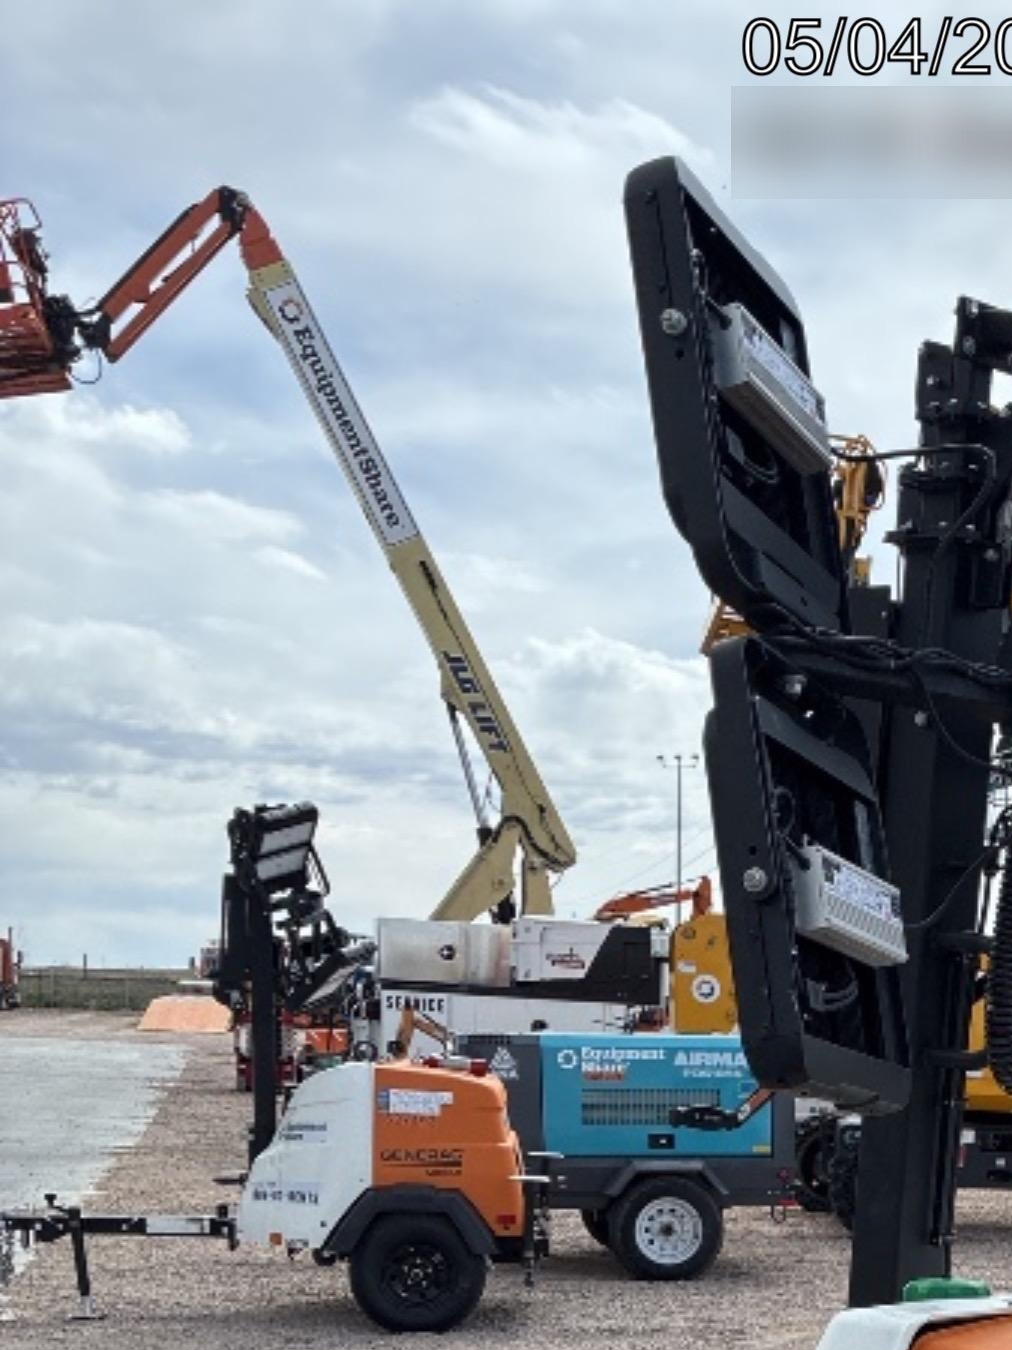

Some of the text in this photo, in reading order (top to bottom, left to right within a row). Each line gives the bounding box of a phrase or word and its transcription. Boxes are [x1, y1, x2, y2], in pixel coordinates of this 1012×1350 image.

[293, 325, 400, 529] EquipmentShare
[442, 650, 509, 753] JLG LIFT
[580, 1046, 748, 1068] Equipment AIRMA
